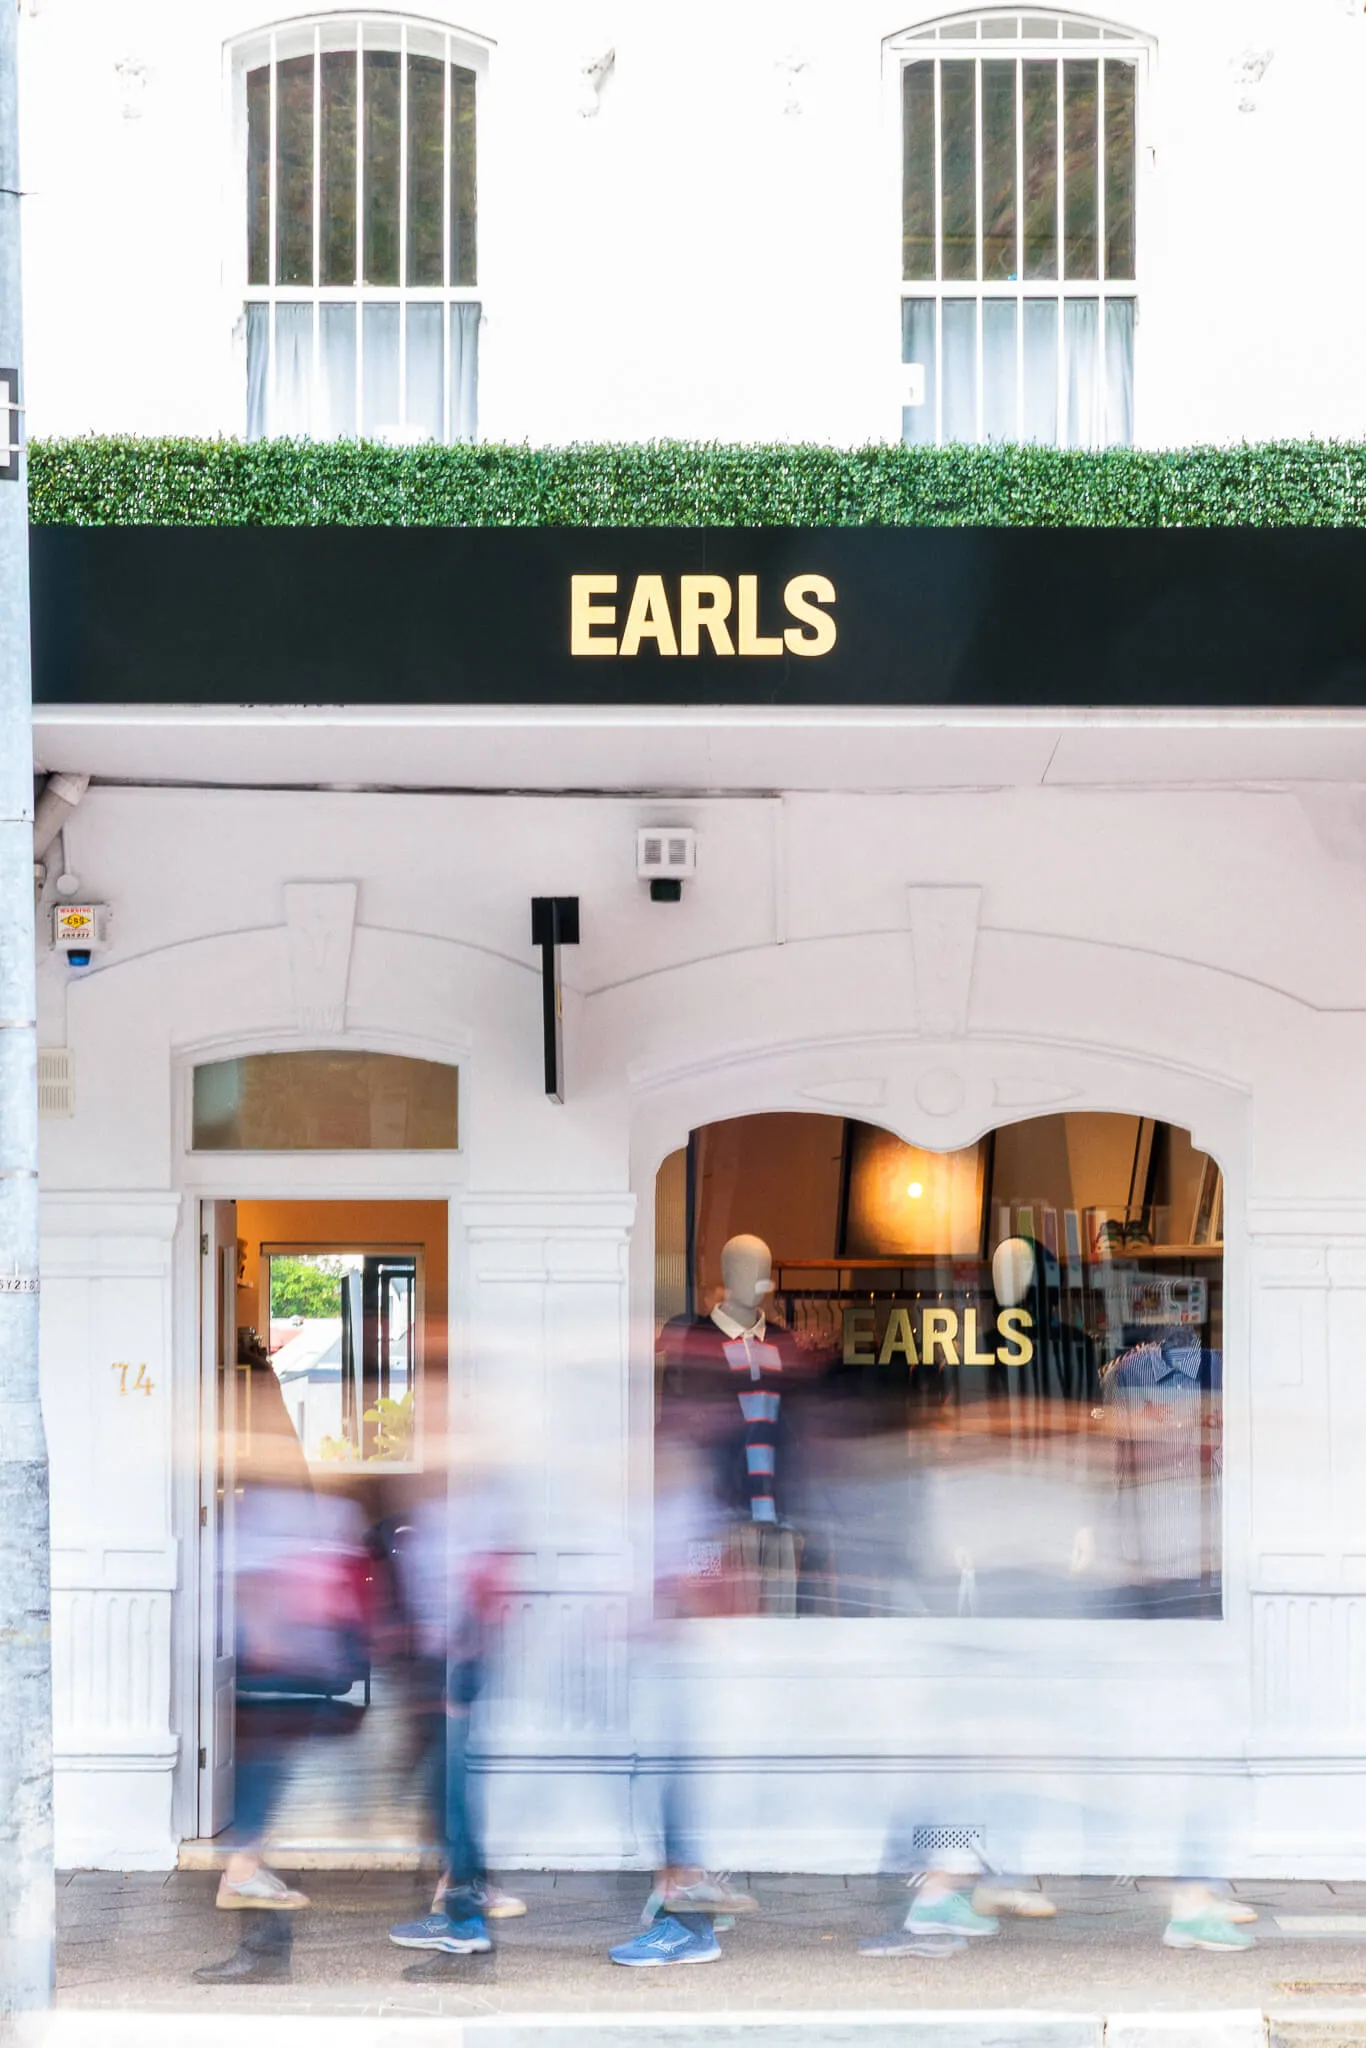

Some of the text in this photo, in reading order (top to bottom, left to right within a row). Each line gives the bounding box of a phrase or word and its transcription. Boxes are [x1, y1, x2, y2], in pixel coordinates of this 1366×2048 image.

[571, 573, 837, 656] EARLS
[843, 1308, 1033, 1366] EARLS
[111, 1363, 154, 1396] 74
